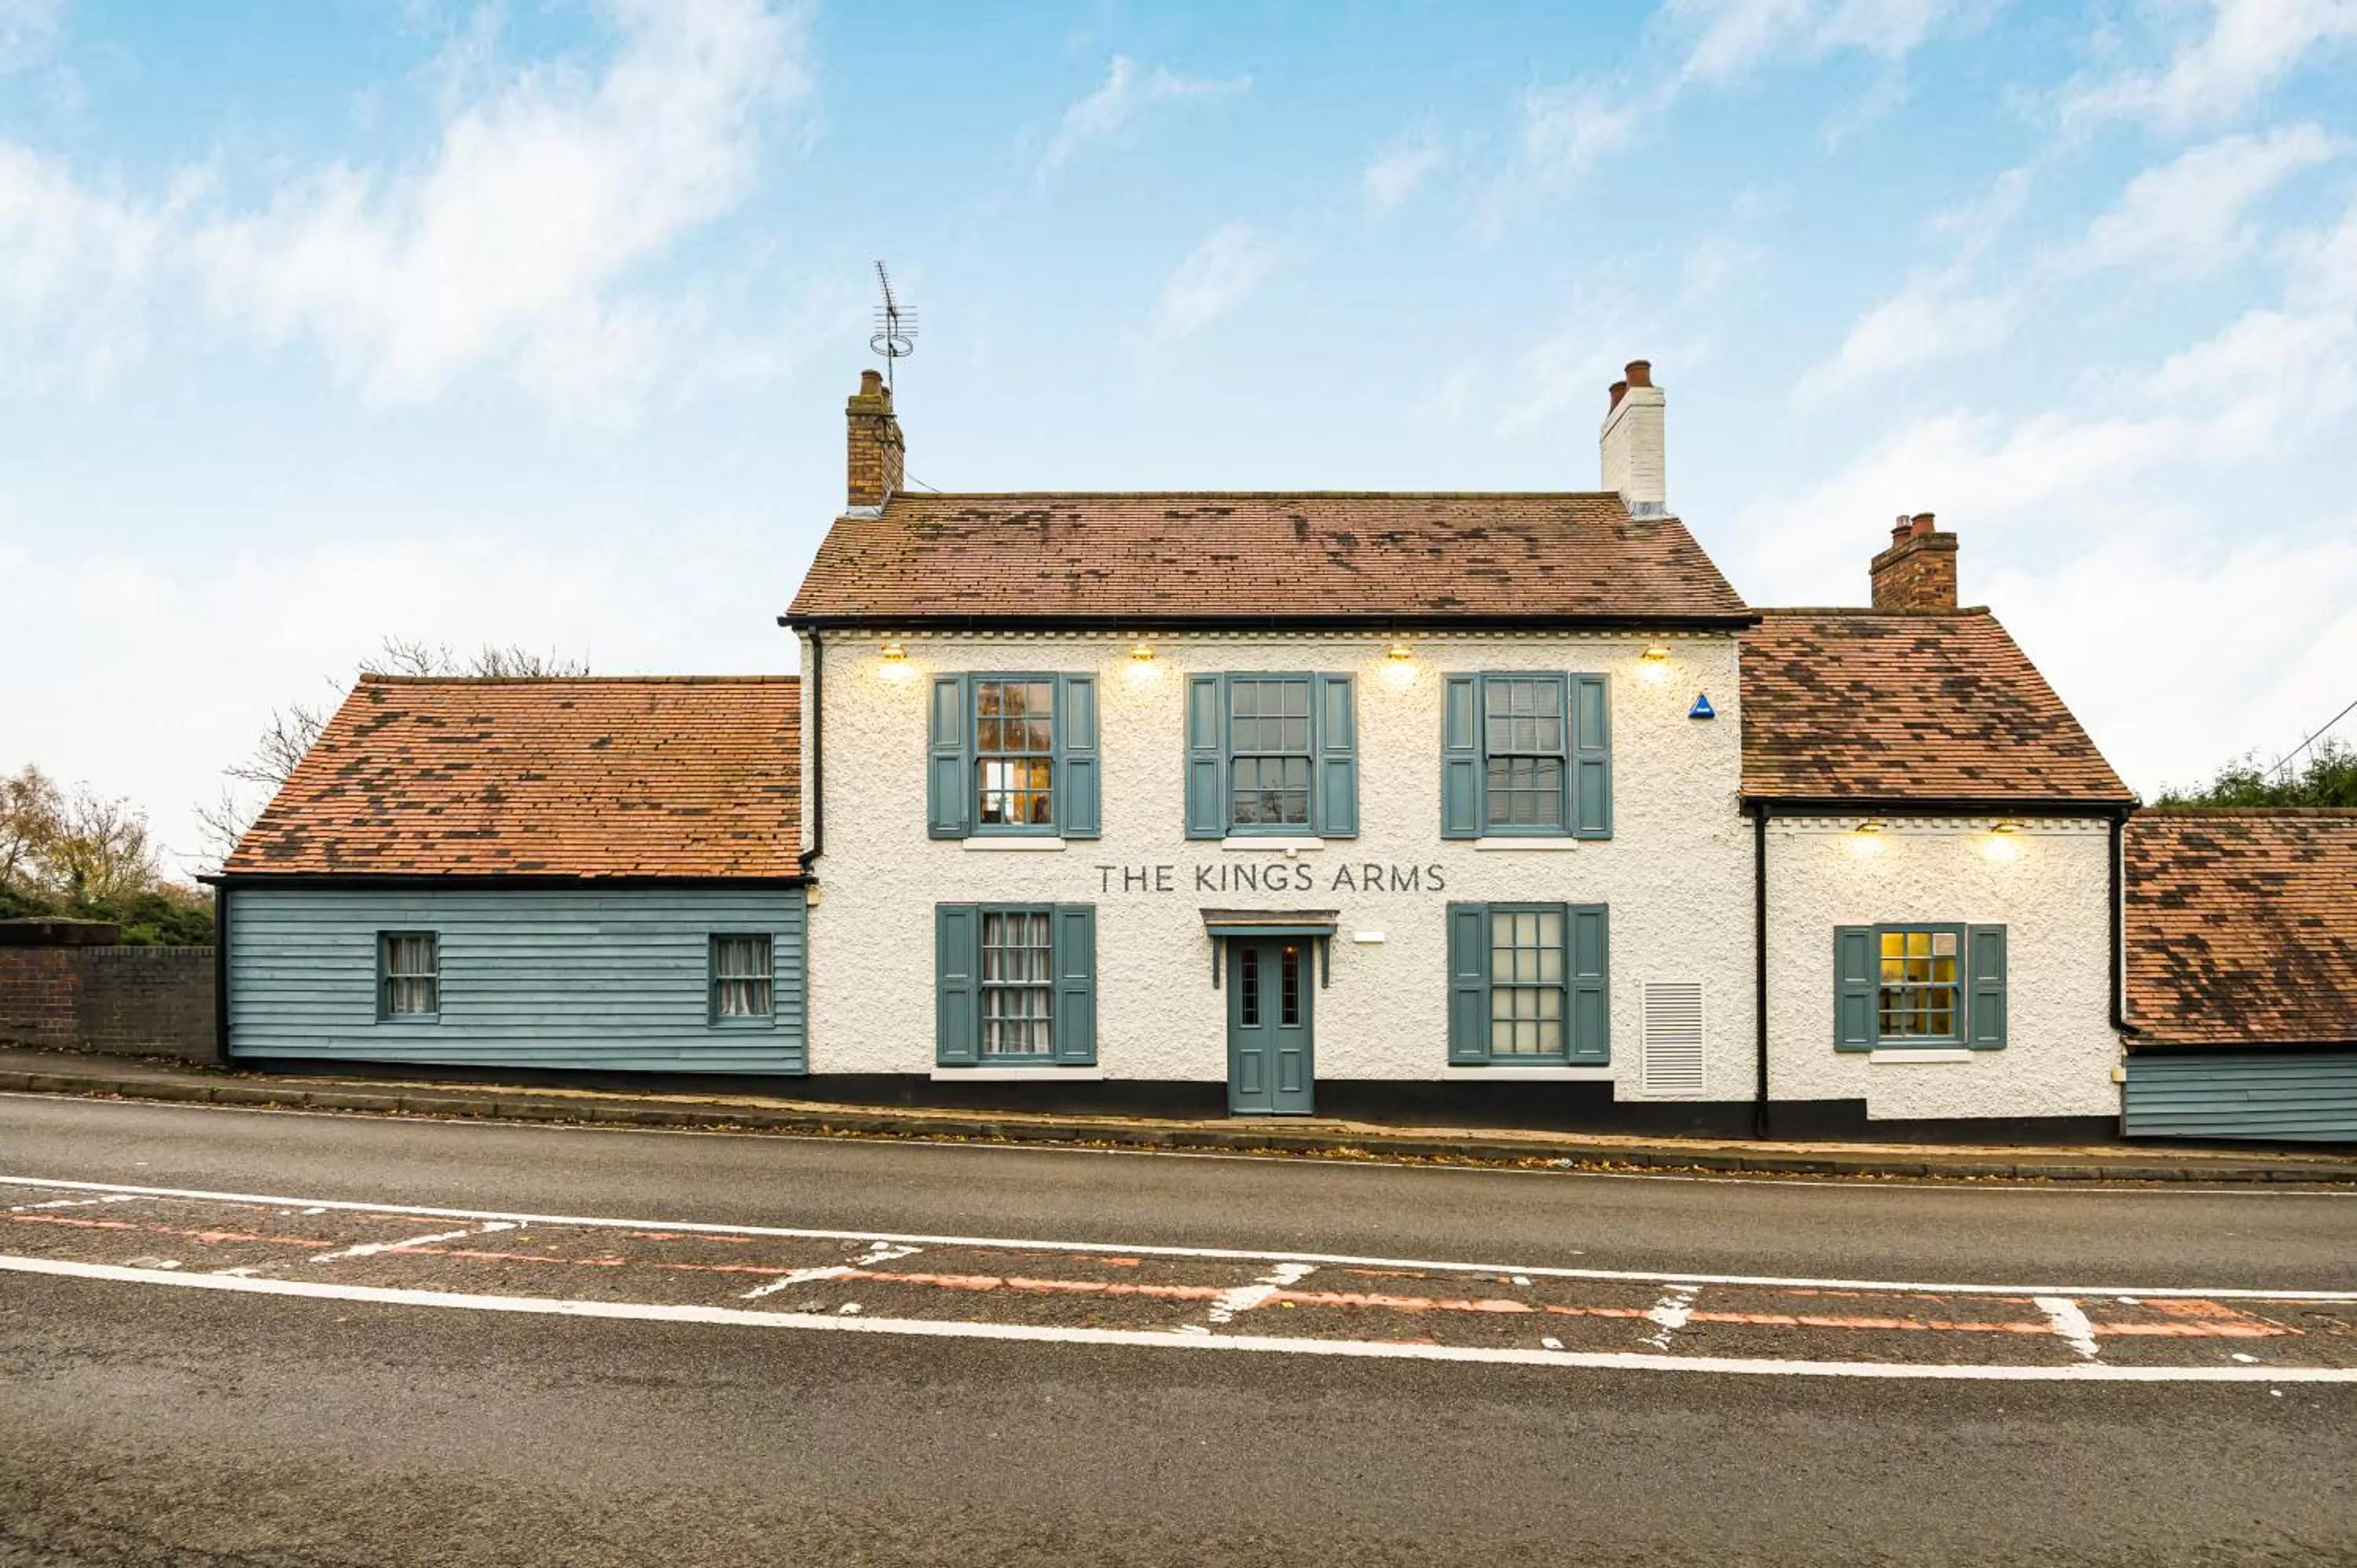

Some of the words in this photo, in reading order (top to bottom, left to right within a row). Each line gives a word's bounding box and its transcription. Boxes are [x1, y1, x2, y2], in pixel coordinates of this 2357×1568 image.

[1096, 865, 1174, 892] THE
[1195, 863, 1313, 892] KINGS
[1332, 863, 1446, 892] ARMS
